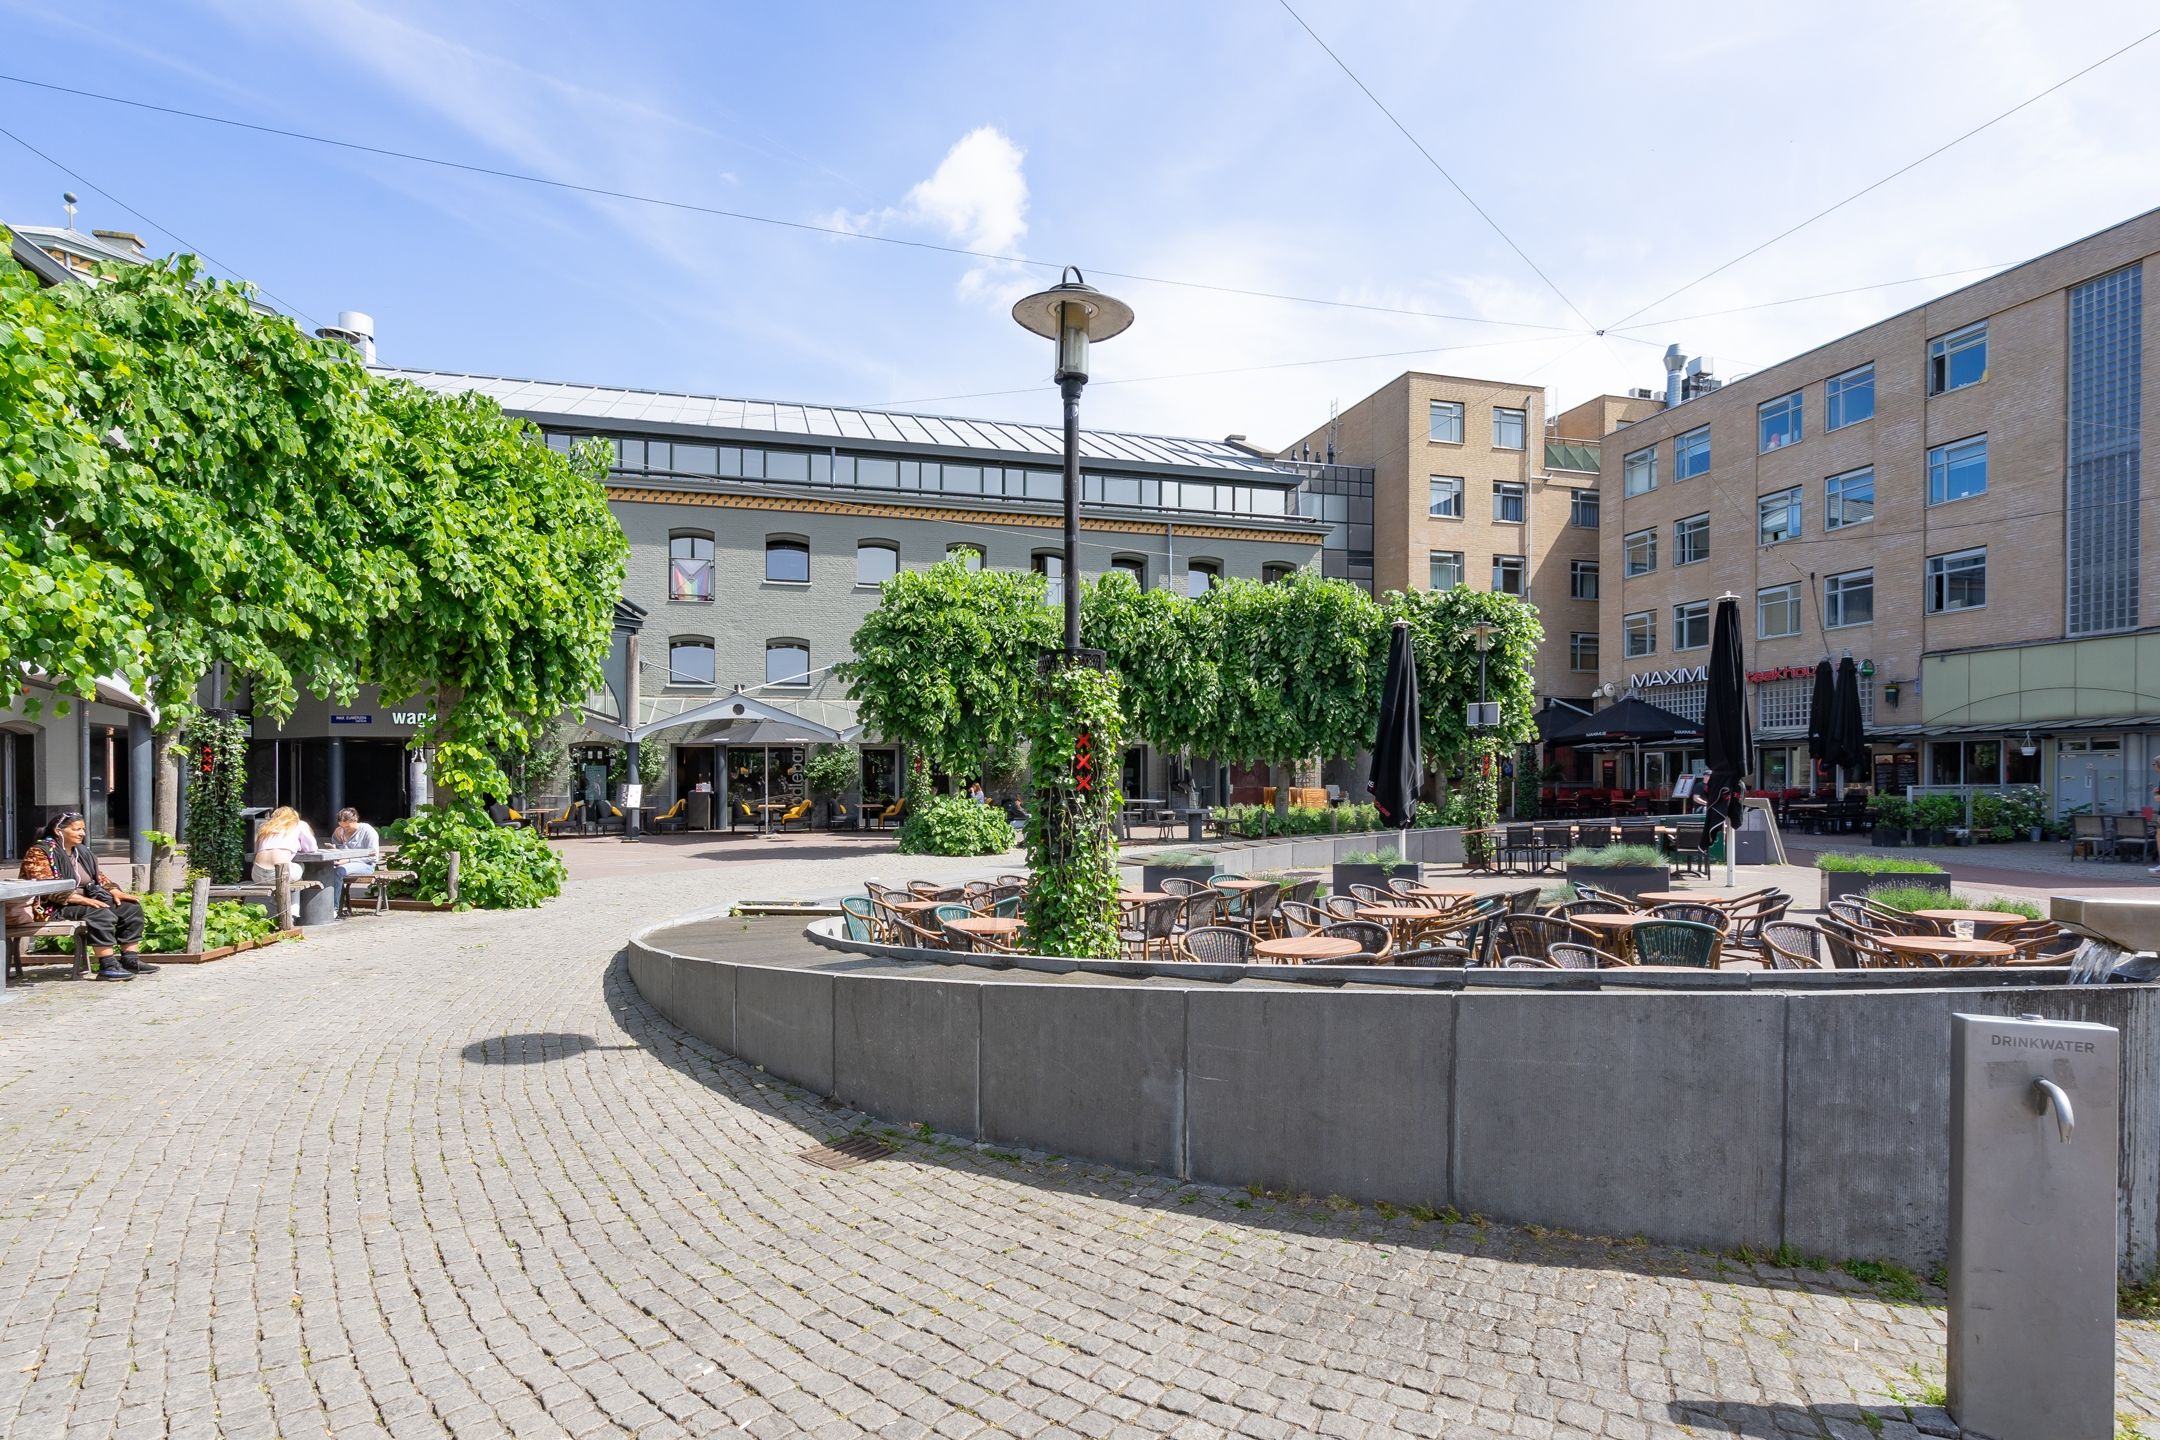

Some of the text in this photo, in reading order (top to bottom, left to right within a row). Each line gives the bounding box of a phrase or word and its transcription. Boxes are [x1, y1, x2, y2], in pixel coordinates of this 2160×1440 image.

[1631, 664, 1819, 688] MAXIMU teakhou
[789, 747, 804, 807] odlebar
[1991, 1034, 2096, 1054] DRINKWATER
